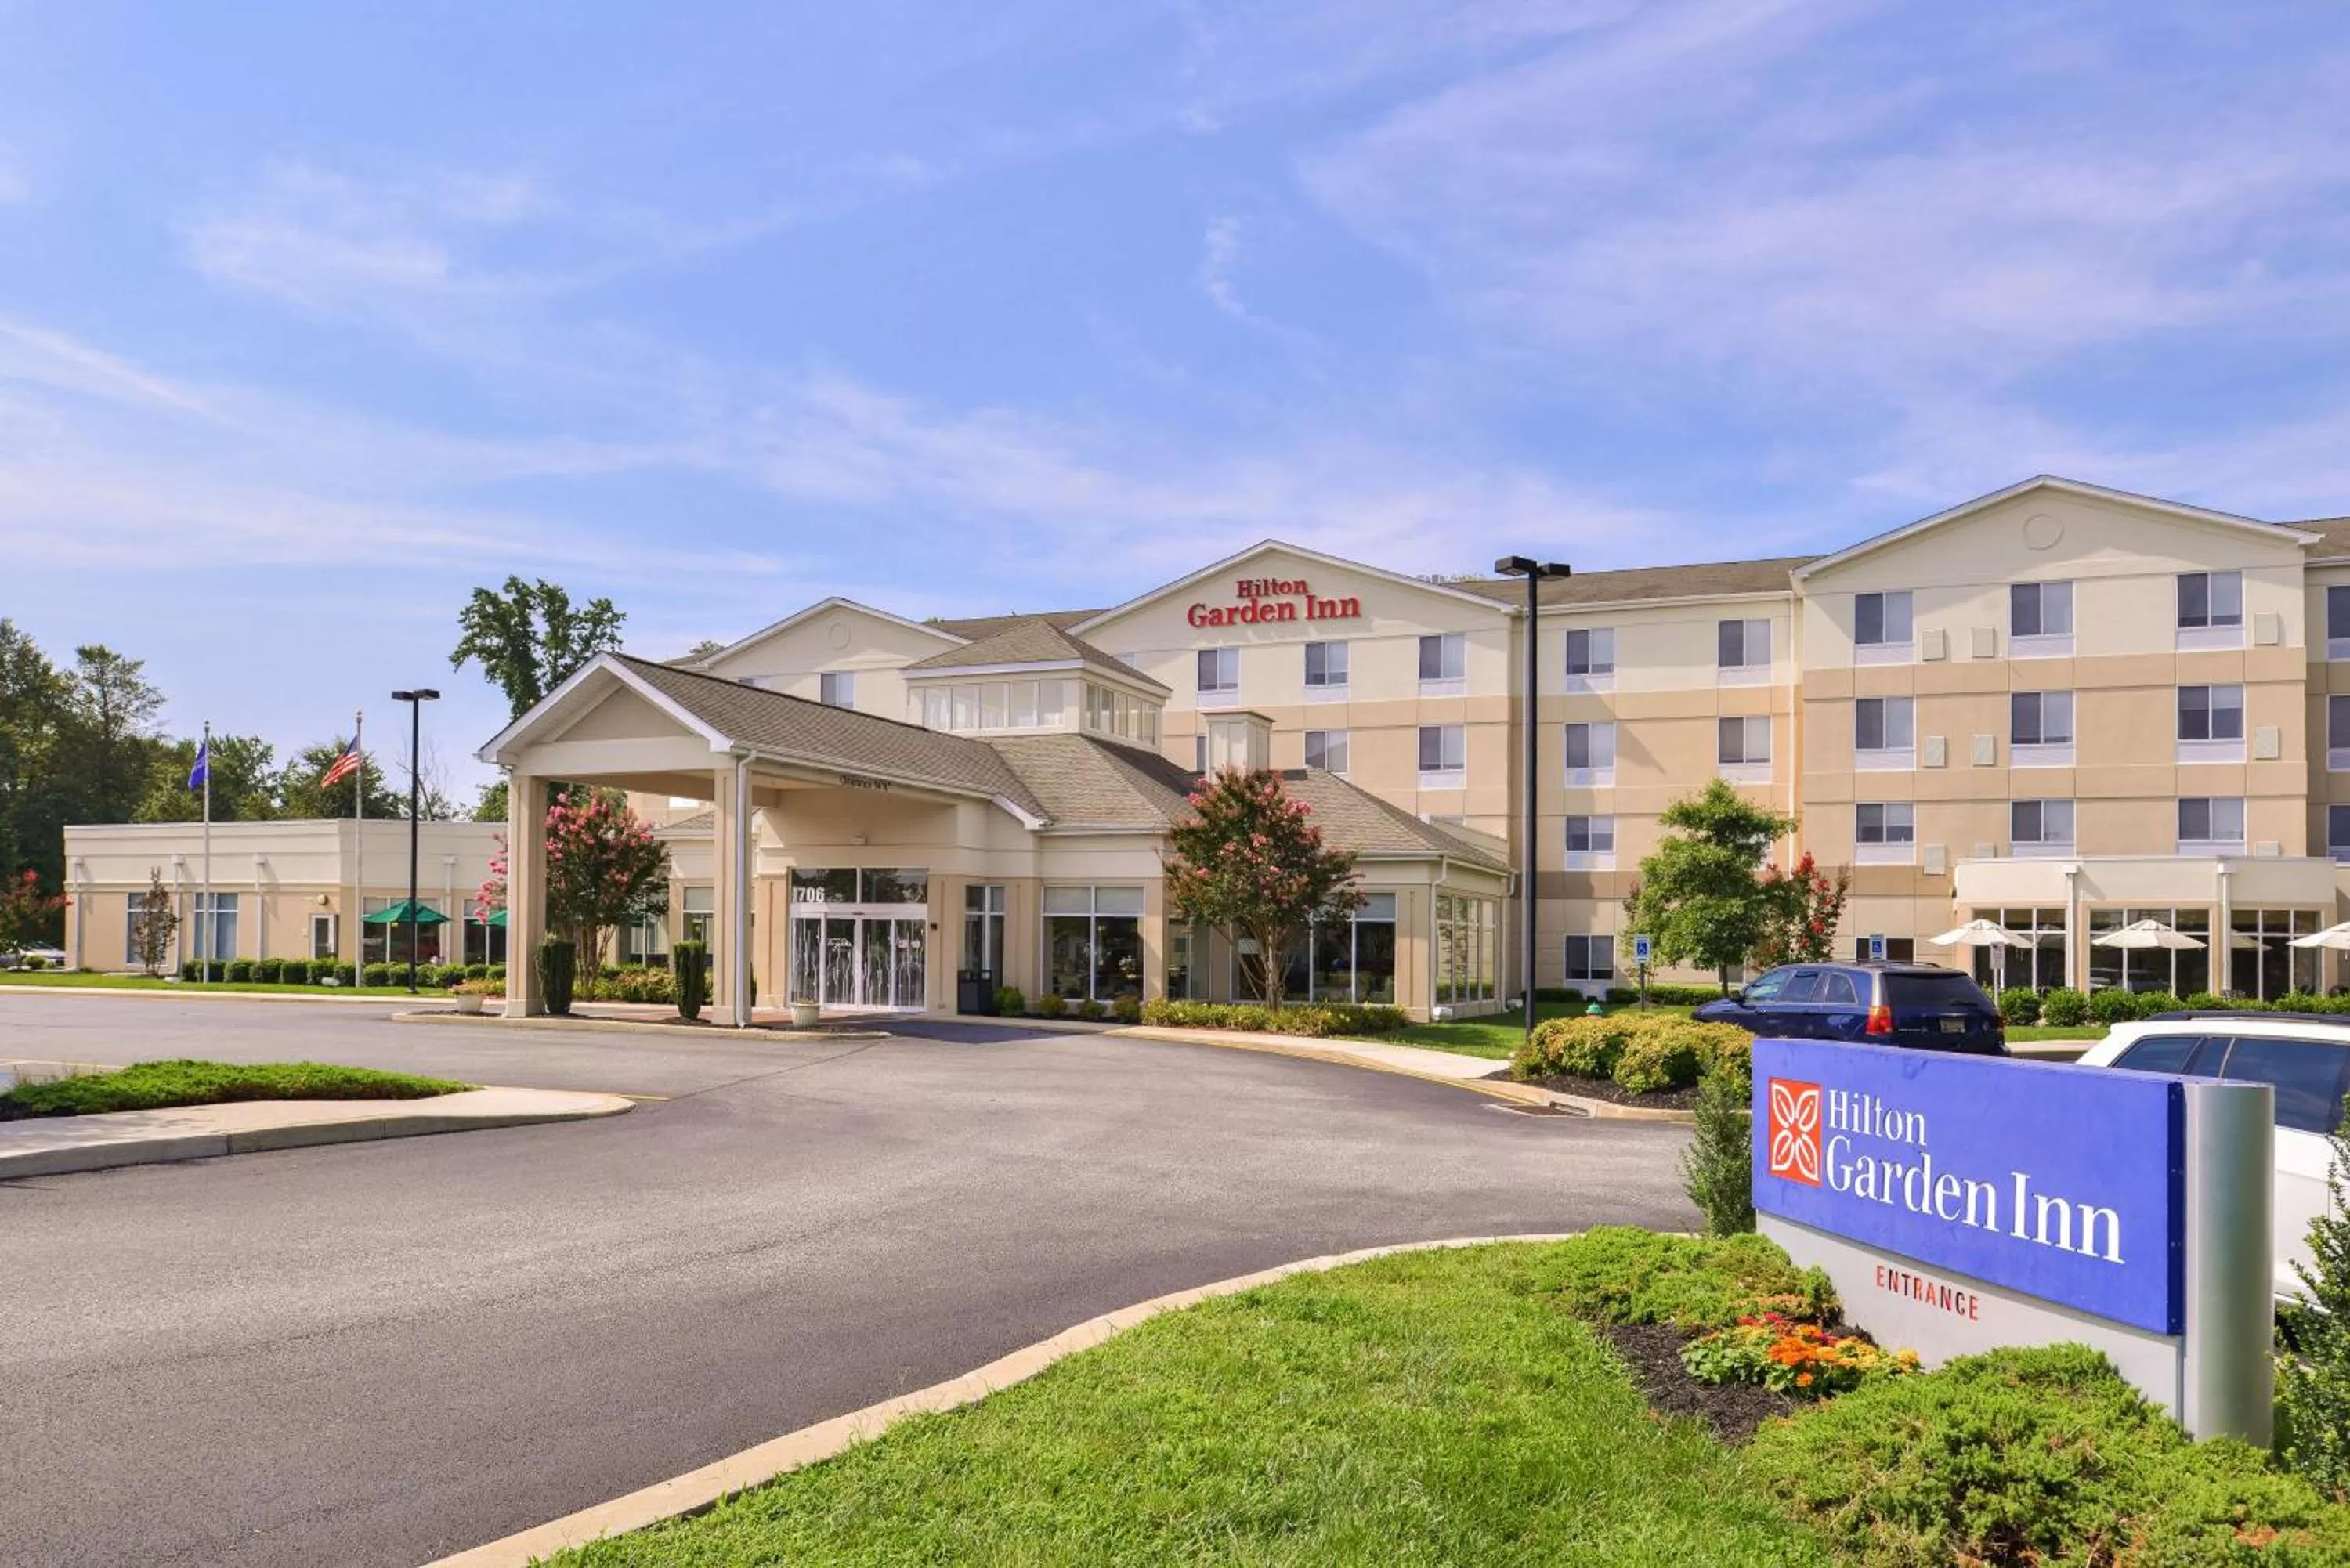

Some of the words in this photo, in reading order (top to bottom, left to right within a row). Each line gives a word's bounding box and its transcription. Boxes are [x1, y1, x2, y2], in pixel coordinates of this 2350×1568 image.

[1188, 598, 1297, 627] Garden
[1305, 594, 1361, 621] Inn
[1236, 579, 1309, 598] Hilton
[1829, 1089, 1927, 1147] Hilton
[1826, 1135, 1999, 1232] Garden
[2009, 1171, 2125, 1265] Inn
[1876, 1265, 1980, 1321] ENTRANCE
